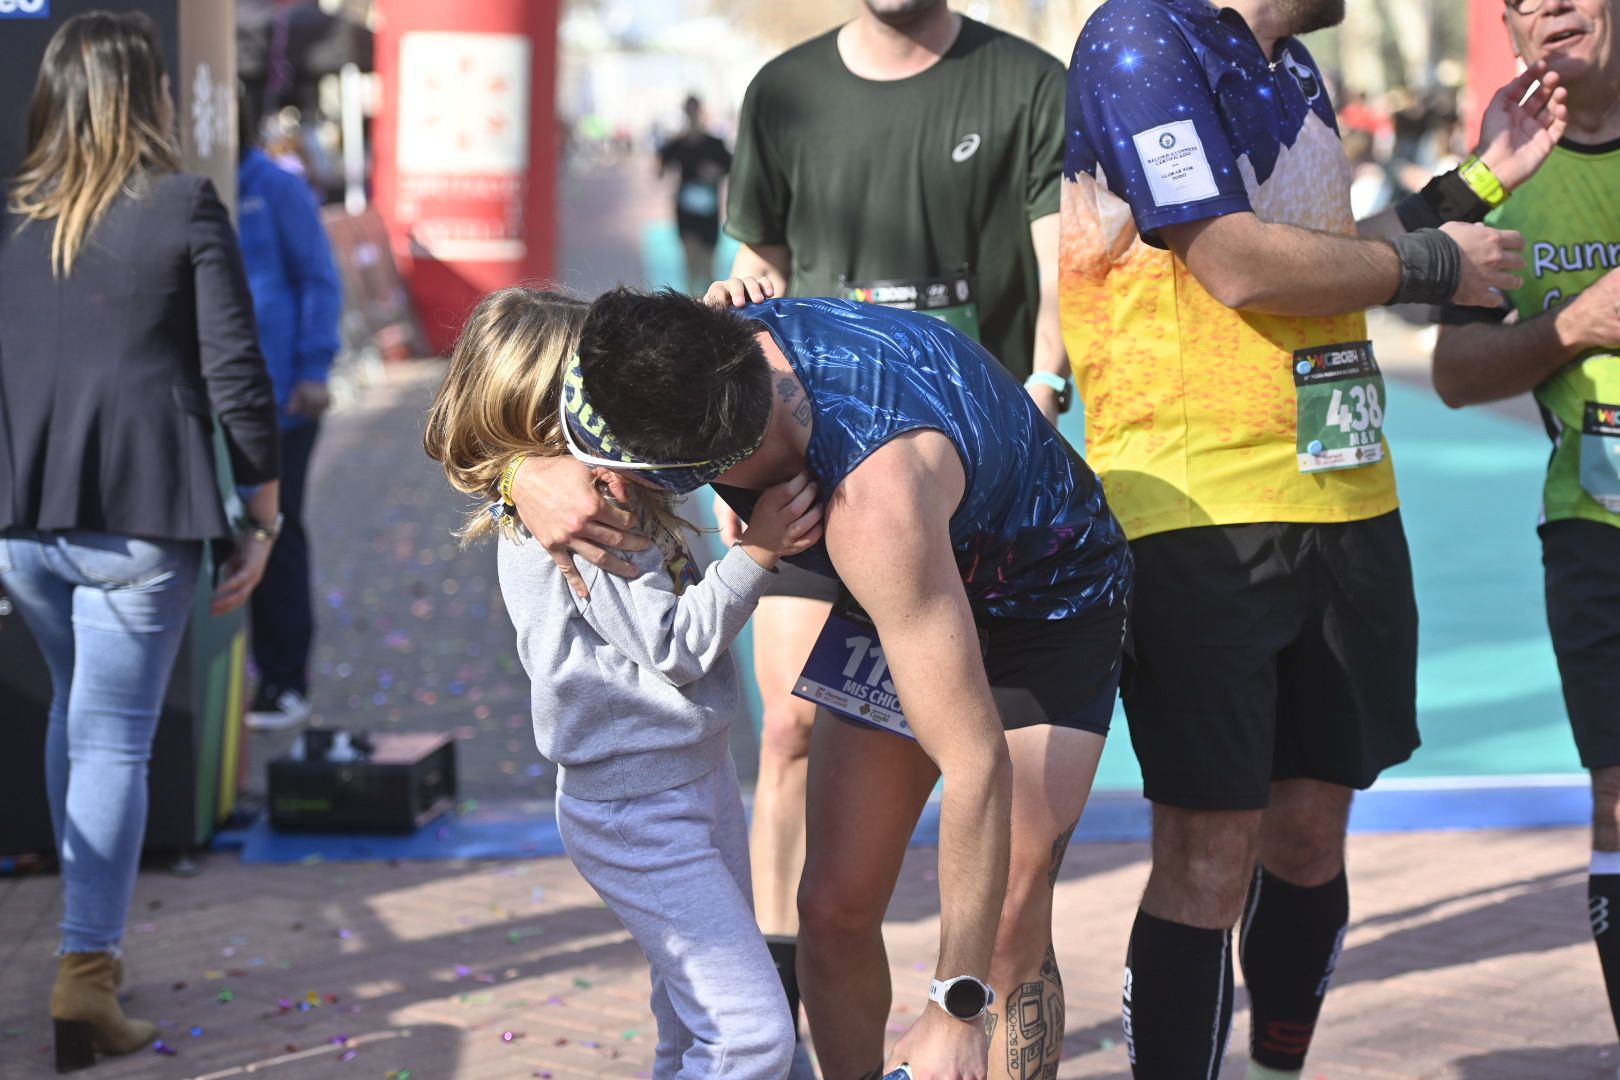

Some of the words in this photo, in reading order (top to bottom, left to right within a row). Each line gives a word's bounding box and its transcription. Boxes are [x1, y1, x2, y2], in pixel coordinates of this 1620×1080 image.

[1326, 383, 1383, 433] 438
[842, 680, 869, 701] MIS
[869, 689, 903, 713] CHIC
[1008, 1002, 1019, 1046] SCHOOL
[1010, 1048, 1019, 1070] OLD
